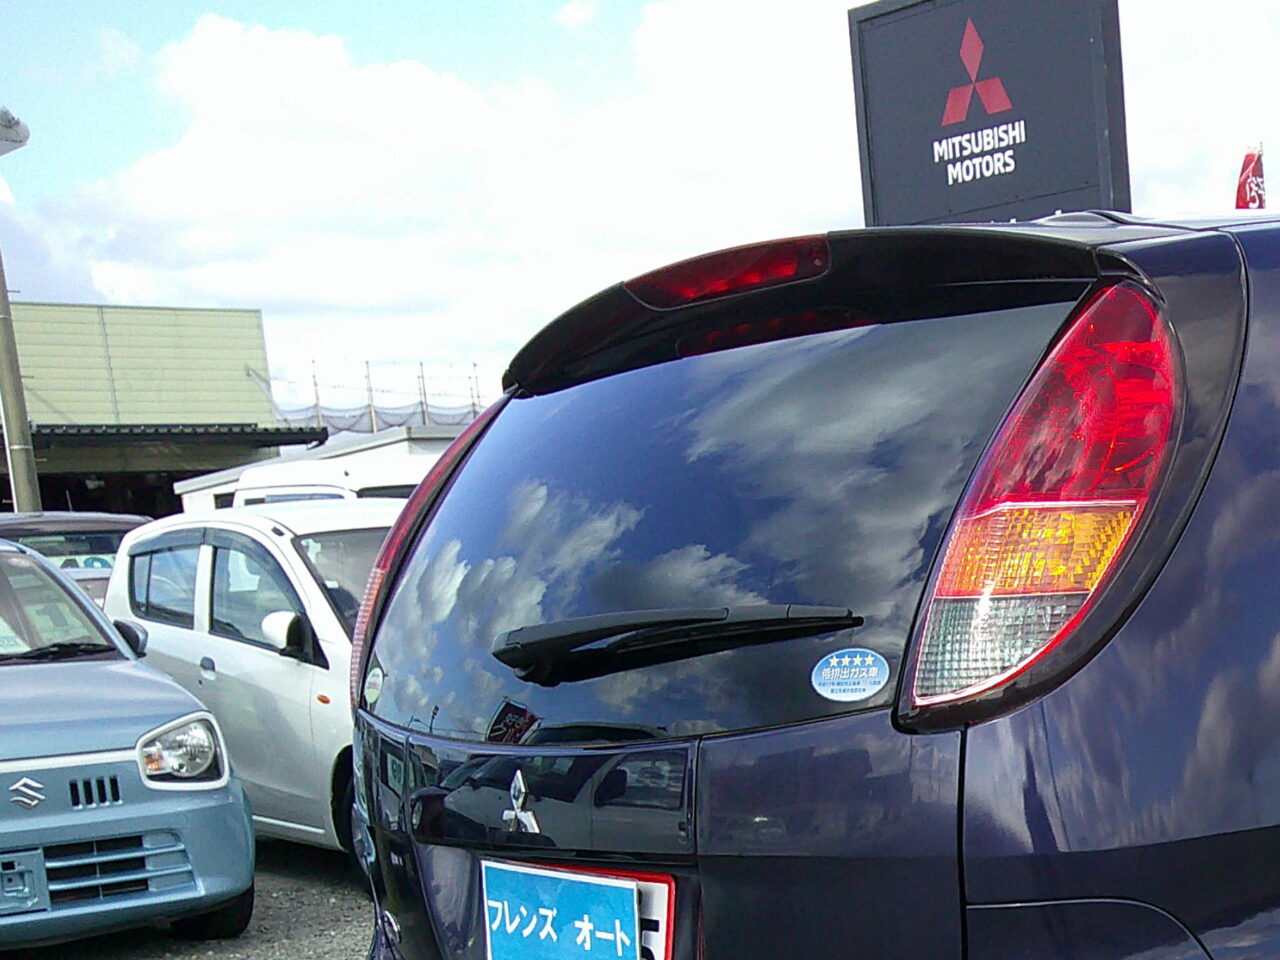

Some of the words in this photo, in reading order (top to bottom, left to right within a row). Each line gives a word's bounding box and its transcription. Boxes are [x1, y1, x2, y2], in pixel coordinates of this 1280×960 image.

[933, 120, 1026, 163] MITSUBISHI
[947, 150, 1016, 185] MOTORS
[486, 899, 558, 943] フレンズ
[574, 913, 632, 957] オート
